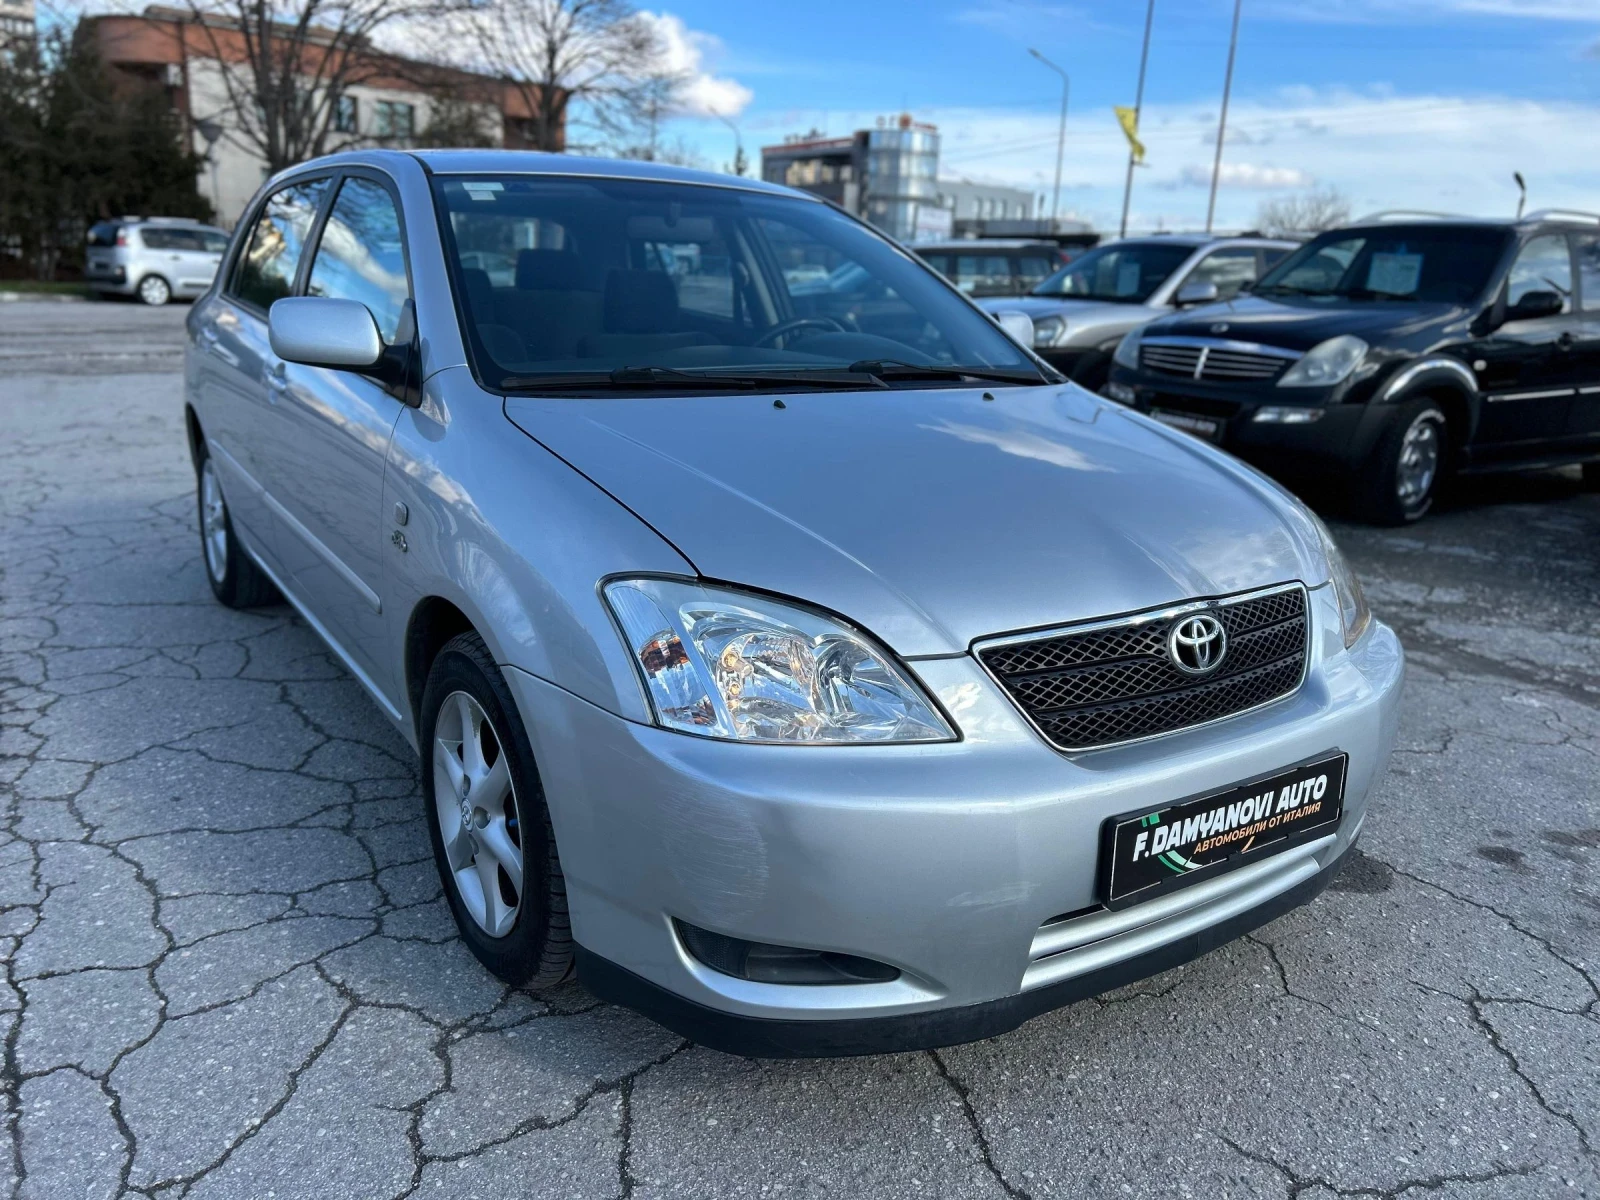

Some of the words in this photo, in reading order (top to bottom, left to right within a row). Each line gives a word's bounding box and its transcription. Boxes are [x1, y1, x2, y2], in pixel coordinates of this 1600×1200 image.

[1132, 790, 1274, 862] F.DAMYANOVI
[1275, 774, 1328, 813] AUTO
[1193, 819, 1267, 855] АВТОМОБИЛИ
[1268, 814, 1282, 828] ОТ
[1282, 801, 1322, 823] ИТАЛИЯ
